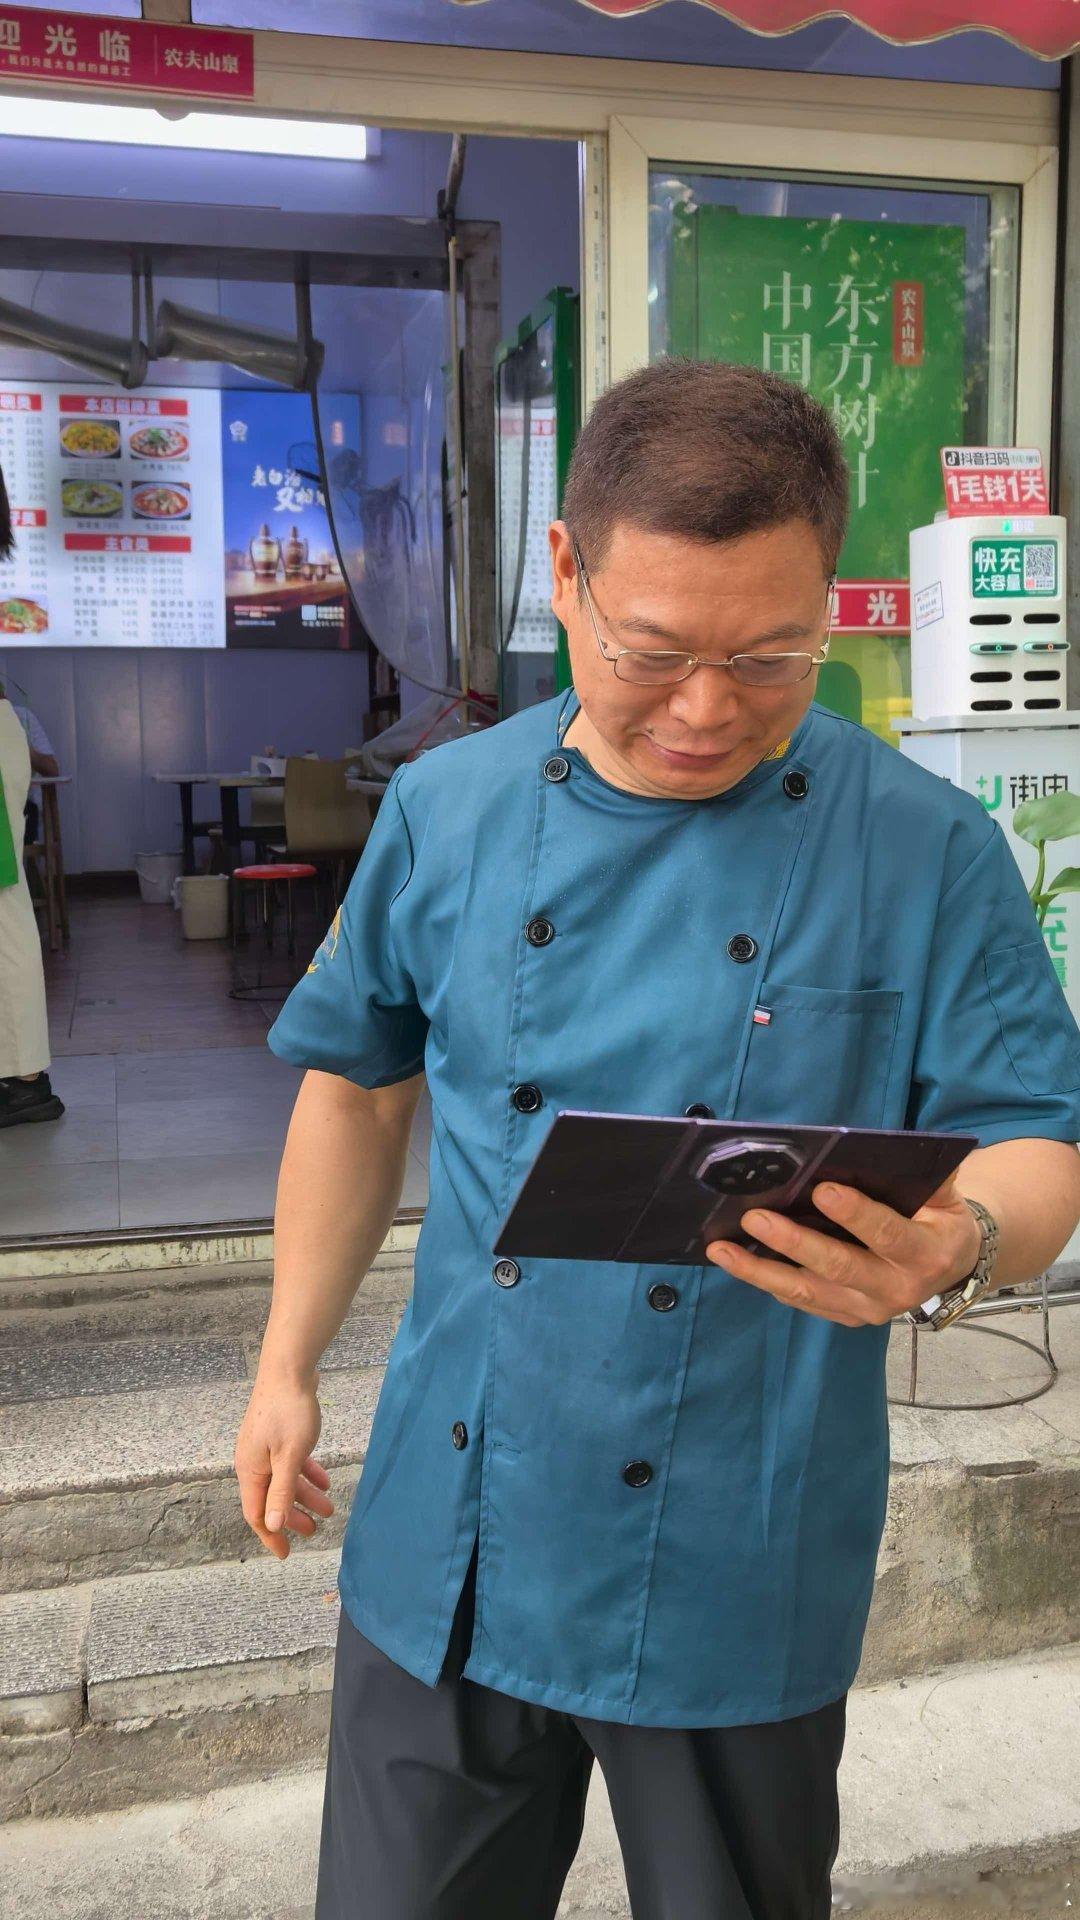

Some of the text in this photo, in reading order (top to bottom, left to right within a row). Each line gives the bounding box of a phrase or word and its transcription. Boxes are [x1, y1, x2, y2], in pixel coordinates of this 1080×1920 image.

[164, 48, 239, 74] 农夫山泉
[901, 288, 916, 358] 农夫山泉
[961, 452, 1010, 466] 抖音扫码
[974, 547, 1021, 573] 快充
[974, 574, 1021, 591] 大容量
